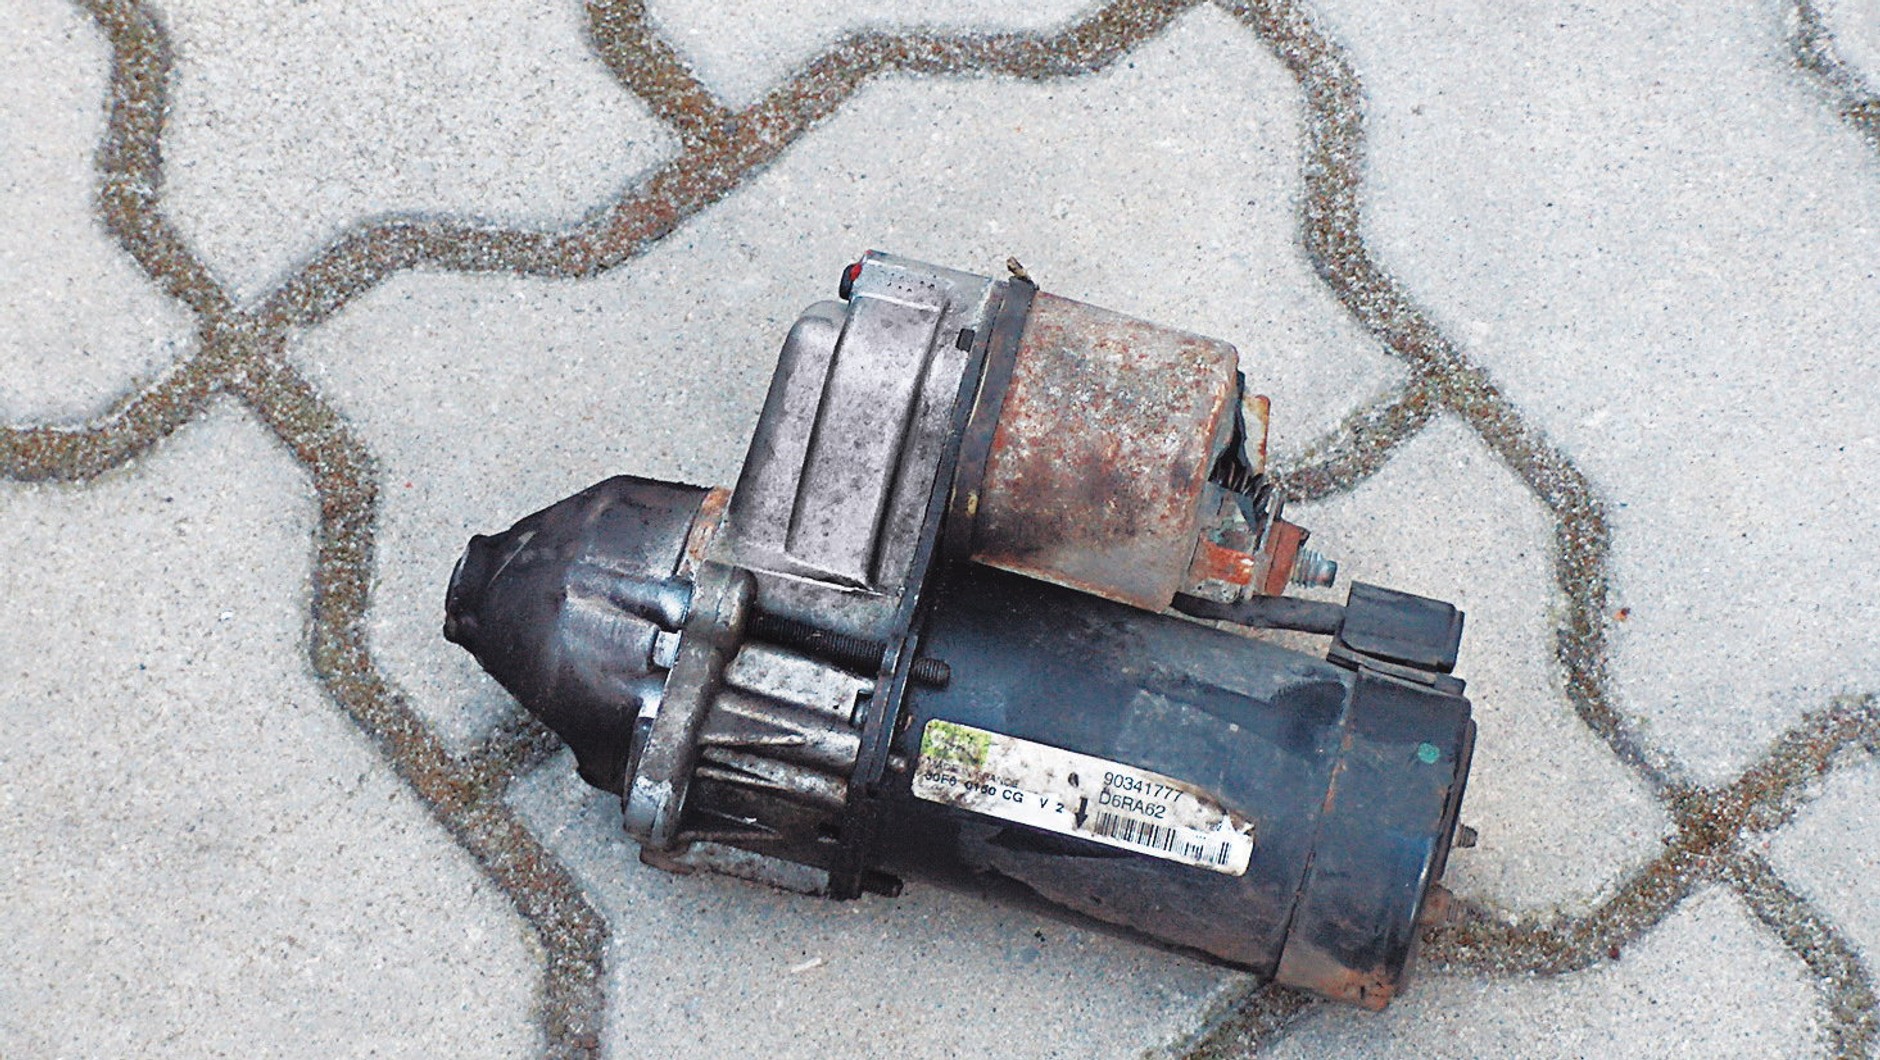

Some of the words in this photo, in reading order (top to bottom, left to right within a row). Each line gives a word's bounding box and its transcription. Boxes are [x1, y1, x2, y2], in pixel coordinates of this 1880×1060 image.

[1103, 771, 1184, 803] 90341777
[1002, 789, 1024, 803] CG
[1039, 797, 1048, 809] V
[1055, 802, 1065, 814] 2
[1098, 791, 1167, 819] D6RA62
